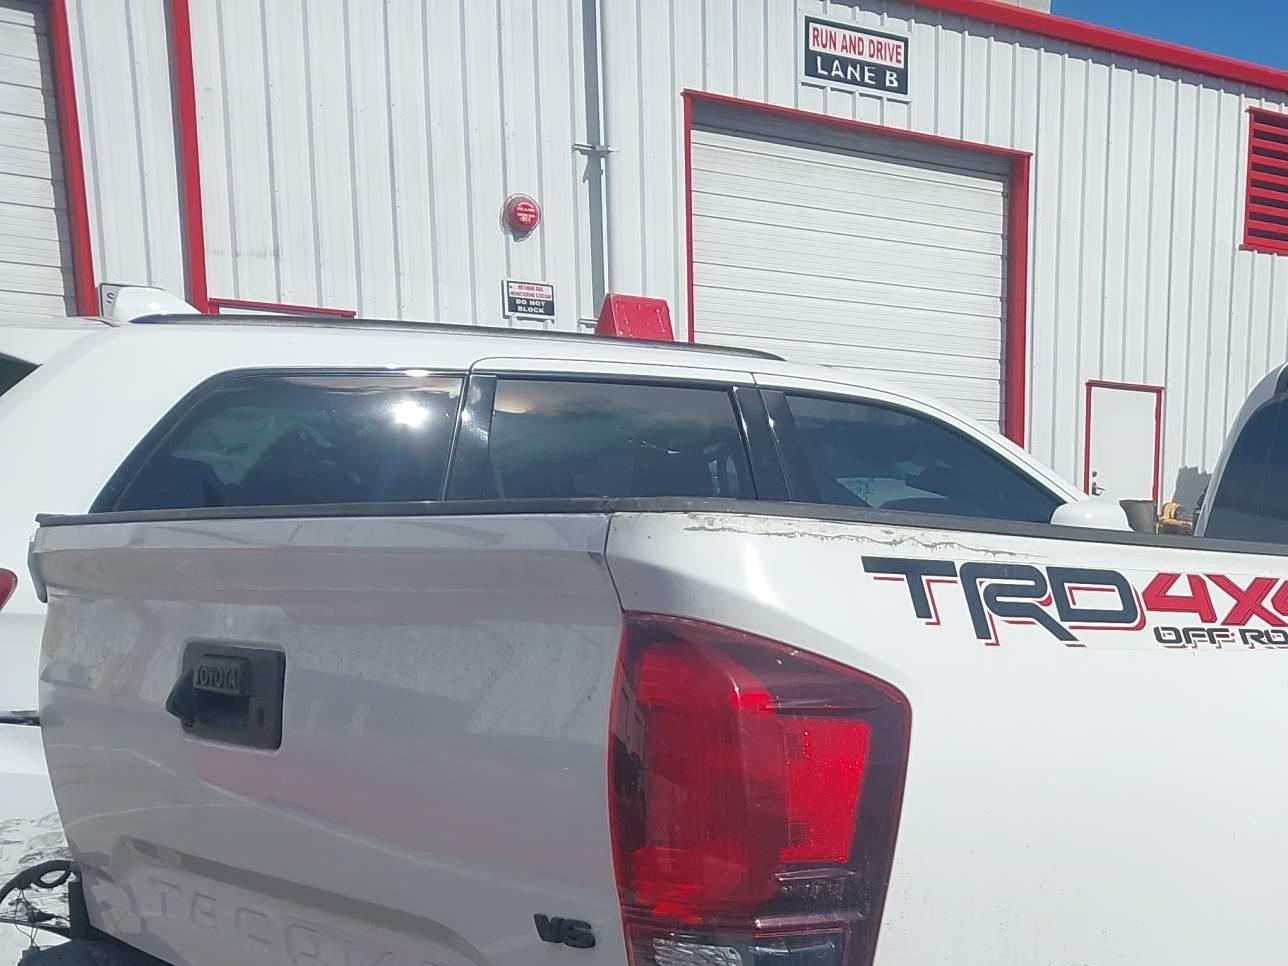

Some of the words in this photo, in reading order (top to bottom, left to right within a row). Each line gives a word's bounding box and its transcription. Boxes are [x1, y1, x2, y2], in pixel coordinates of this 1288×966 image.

[812, 26, 837, 51] RUN
[841, 34, 865, 56] AND
[868, 39, 902, 63] DRIVE
[816, 55, 876, 84] LANE
[885, 69, 899, 88] B
[861, 556, 1145, 647] TRD
[1154, 626, 1236, 648] OFF
[193, 663, 238, 689] TOYOTA
[533, 913, 596, 949] V6
